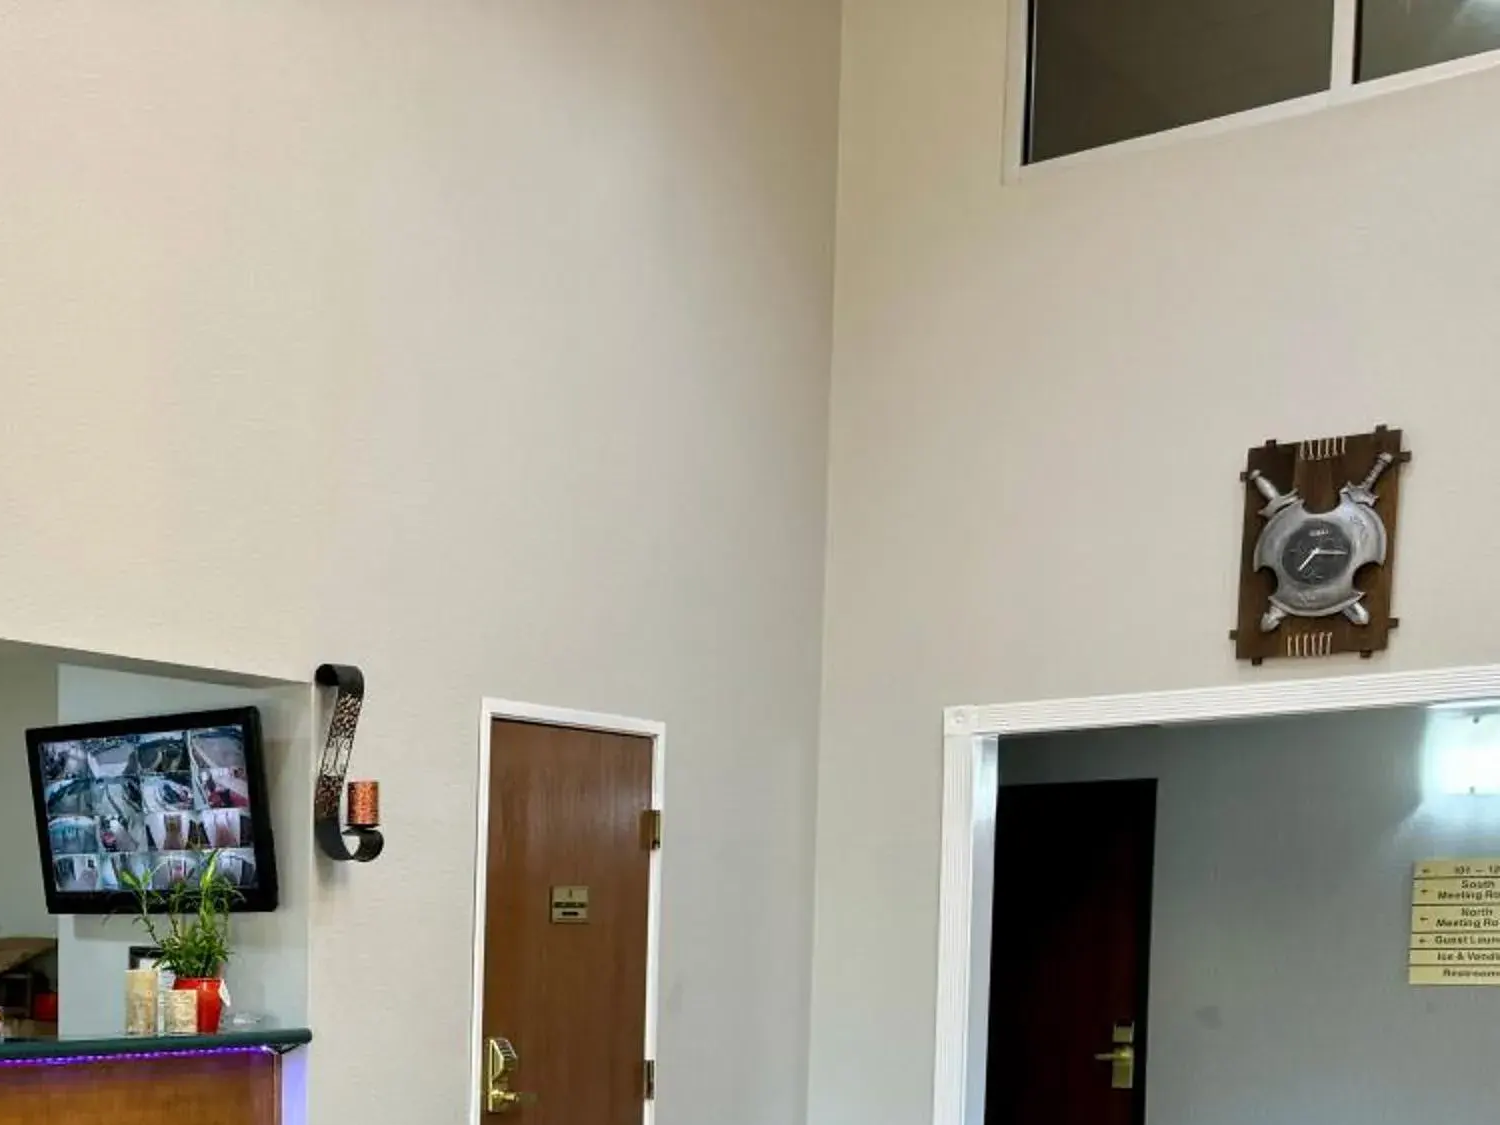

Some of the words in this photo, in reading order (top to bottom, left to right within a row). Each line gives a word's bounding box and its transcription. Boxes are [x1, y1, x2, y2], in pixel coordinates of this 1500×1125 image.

[1461, 879, 1494, 889] South
[1437, 890, 1482, 901] Meeting
[1460, 907, 1493, 917] North
[1435, 918, 1481, 928] Meeting
[1483, 918, 1500, 927] Ro
[1434, 935, 1467, 945] Guest
[1437, 952, 1454, 961] Ice
